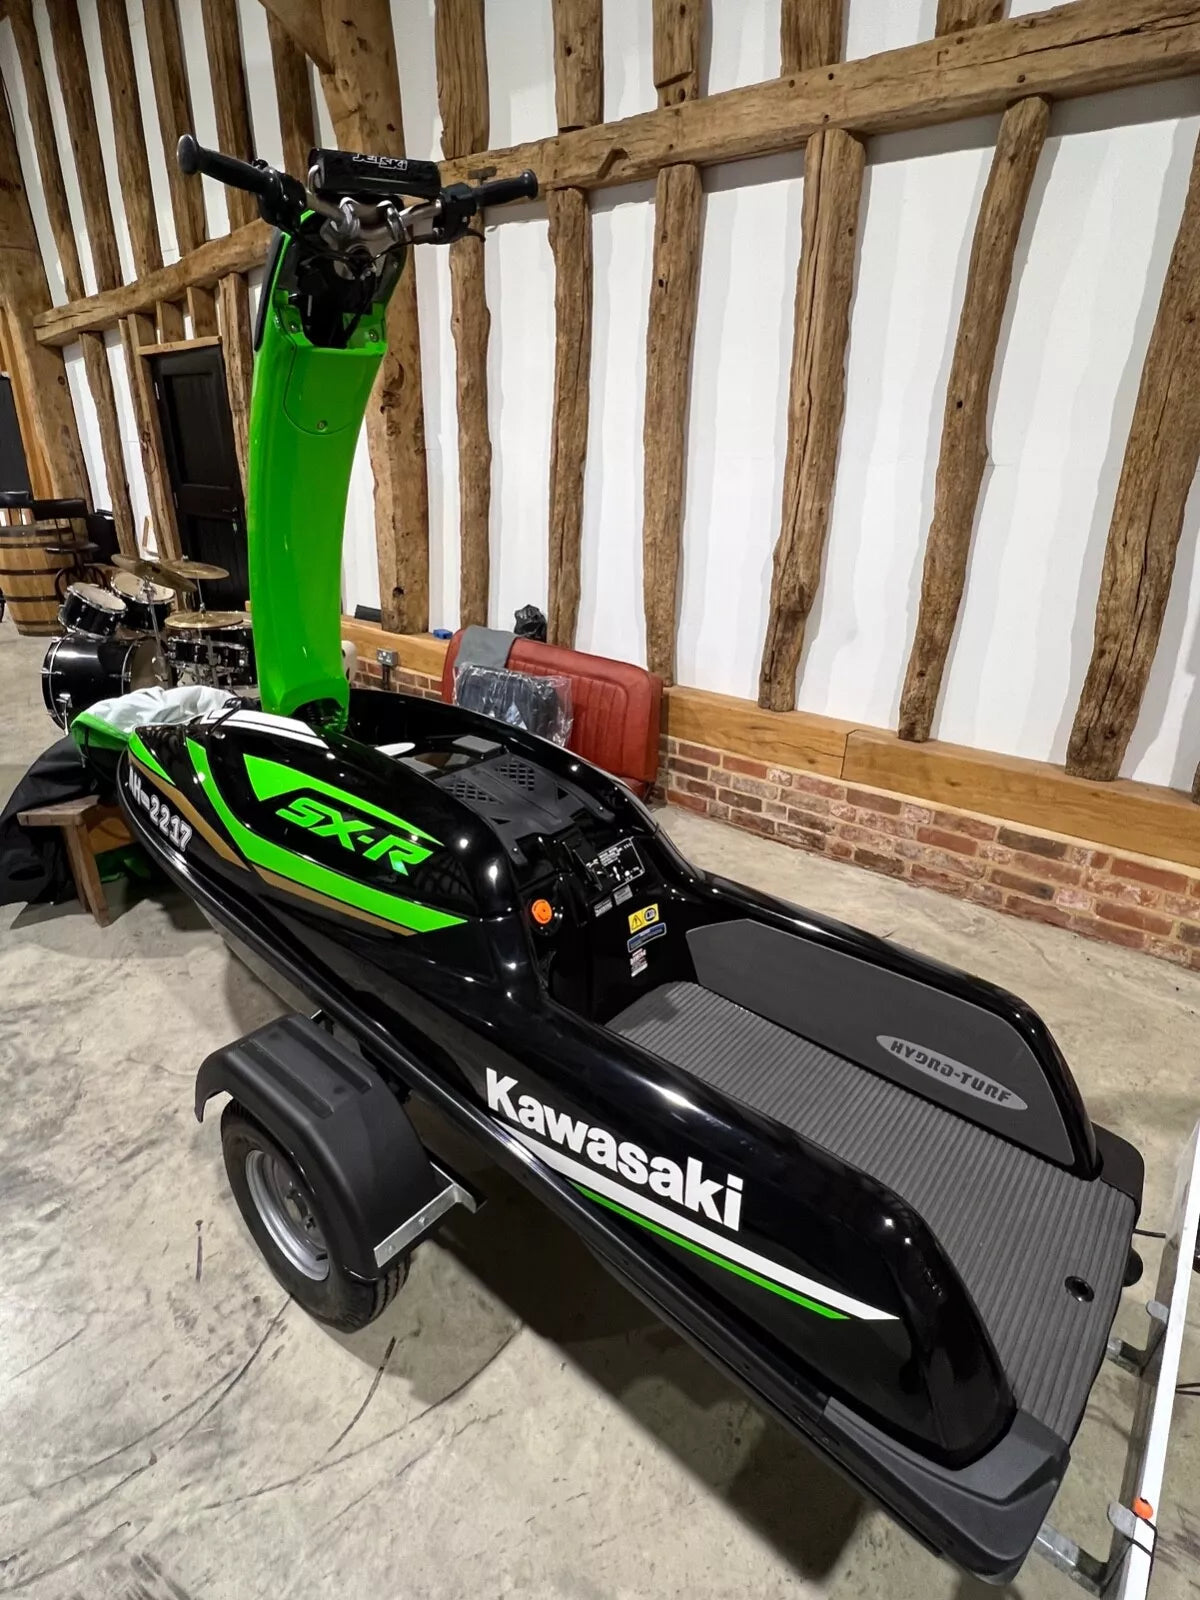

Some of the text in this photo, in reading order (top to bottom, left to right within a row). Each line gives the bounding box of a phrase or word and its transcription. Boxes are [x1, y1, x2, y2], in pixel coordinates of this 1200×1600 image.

[275, 797, 434, 876] SX-R
[890, 1040, 1012, 1102] HYDRO-TURF
[486, 1067, 743, 1232] Kawasaki
